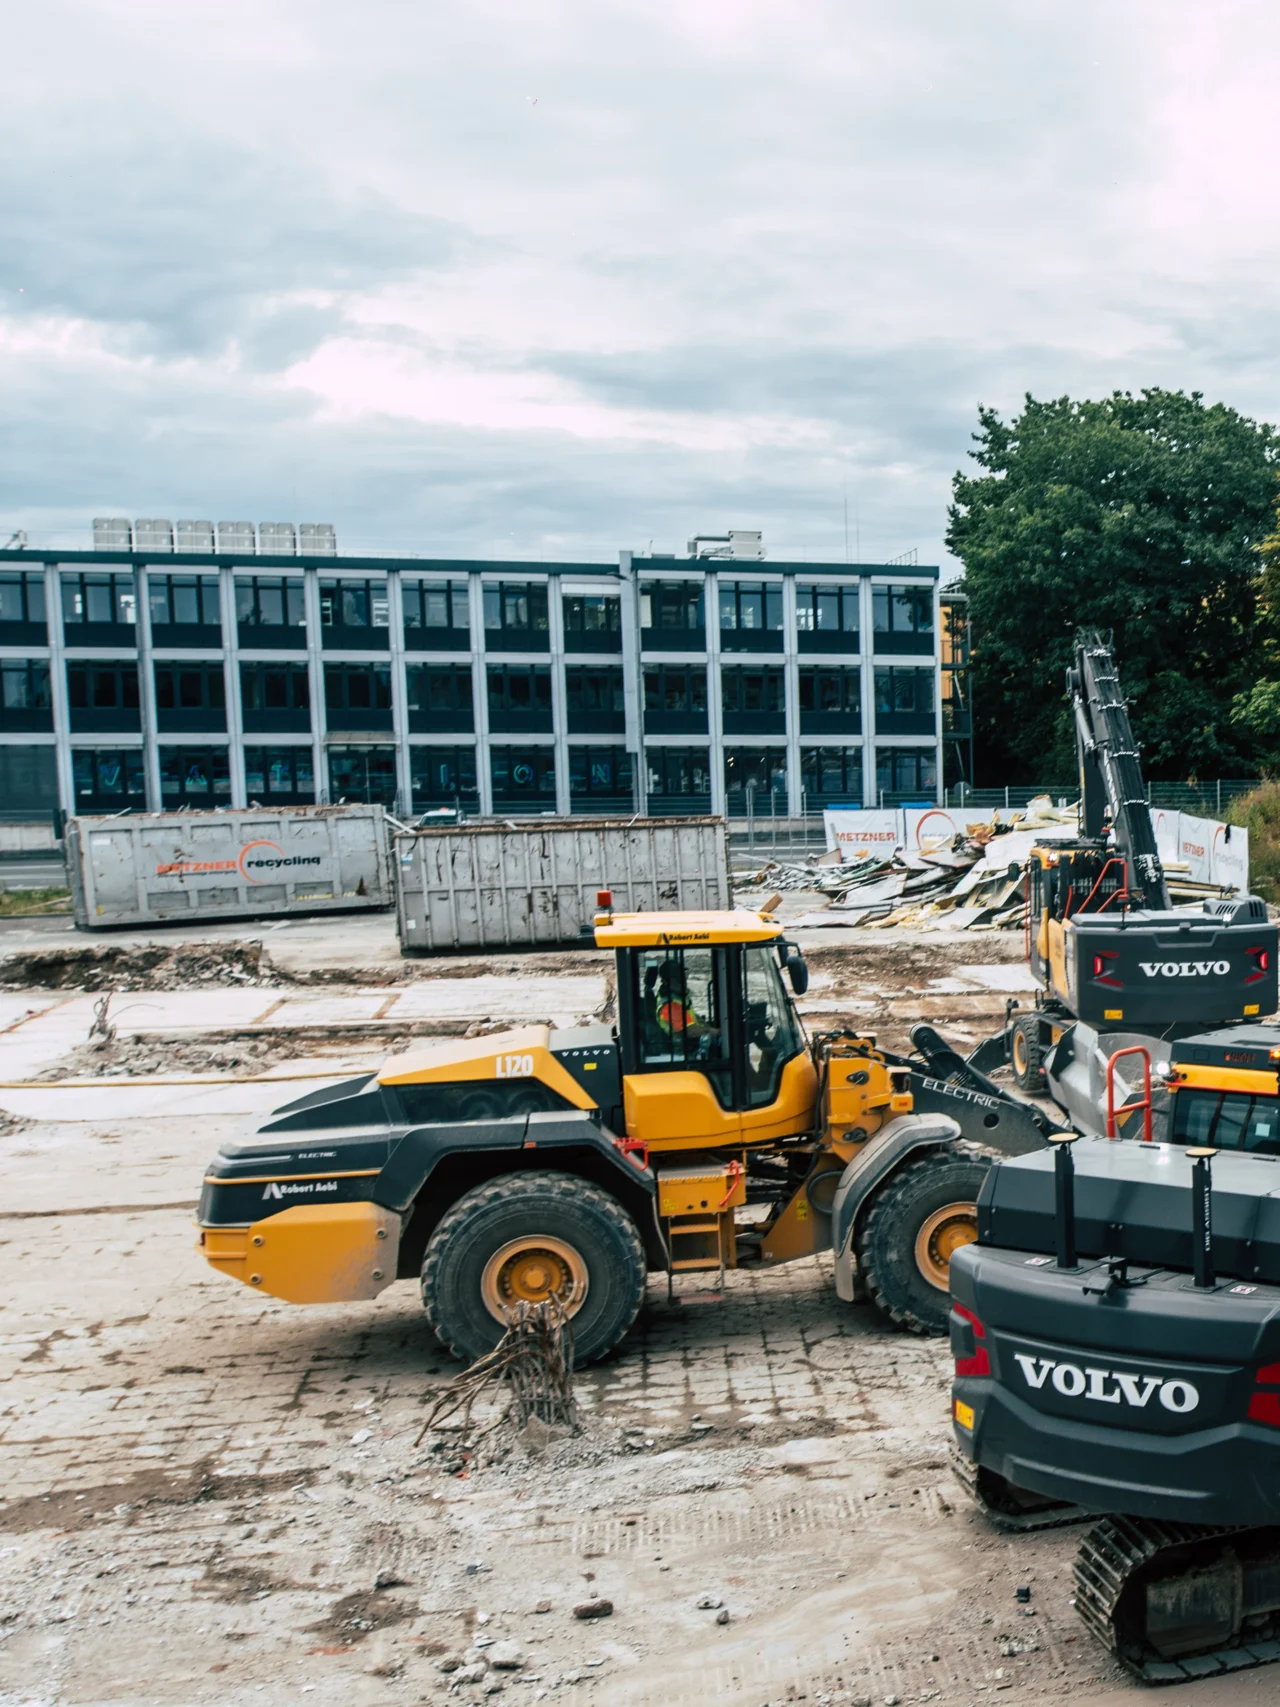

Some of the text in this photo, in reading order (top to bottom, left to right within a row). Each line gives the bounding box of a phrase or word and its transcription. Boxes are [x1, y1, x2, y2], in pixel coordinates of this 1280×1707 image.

[837, 831, 896, 842] METZNER
[247, 855, 321, 869] recycling
[1138, 960, 1231, 977] VOLVO
[561, 1049, 611, 1057] VOLVO
[495, 1055, 534, 1078] L120
[922, 1078, 1000, 1110] ELECTRIC
[298, 1151, 338, 1159] ELECTRIC
[281, 1184, 314, 1194] Robert
[1014, 1353, 1200, 1414] VOLVO
